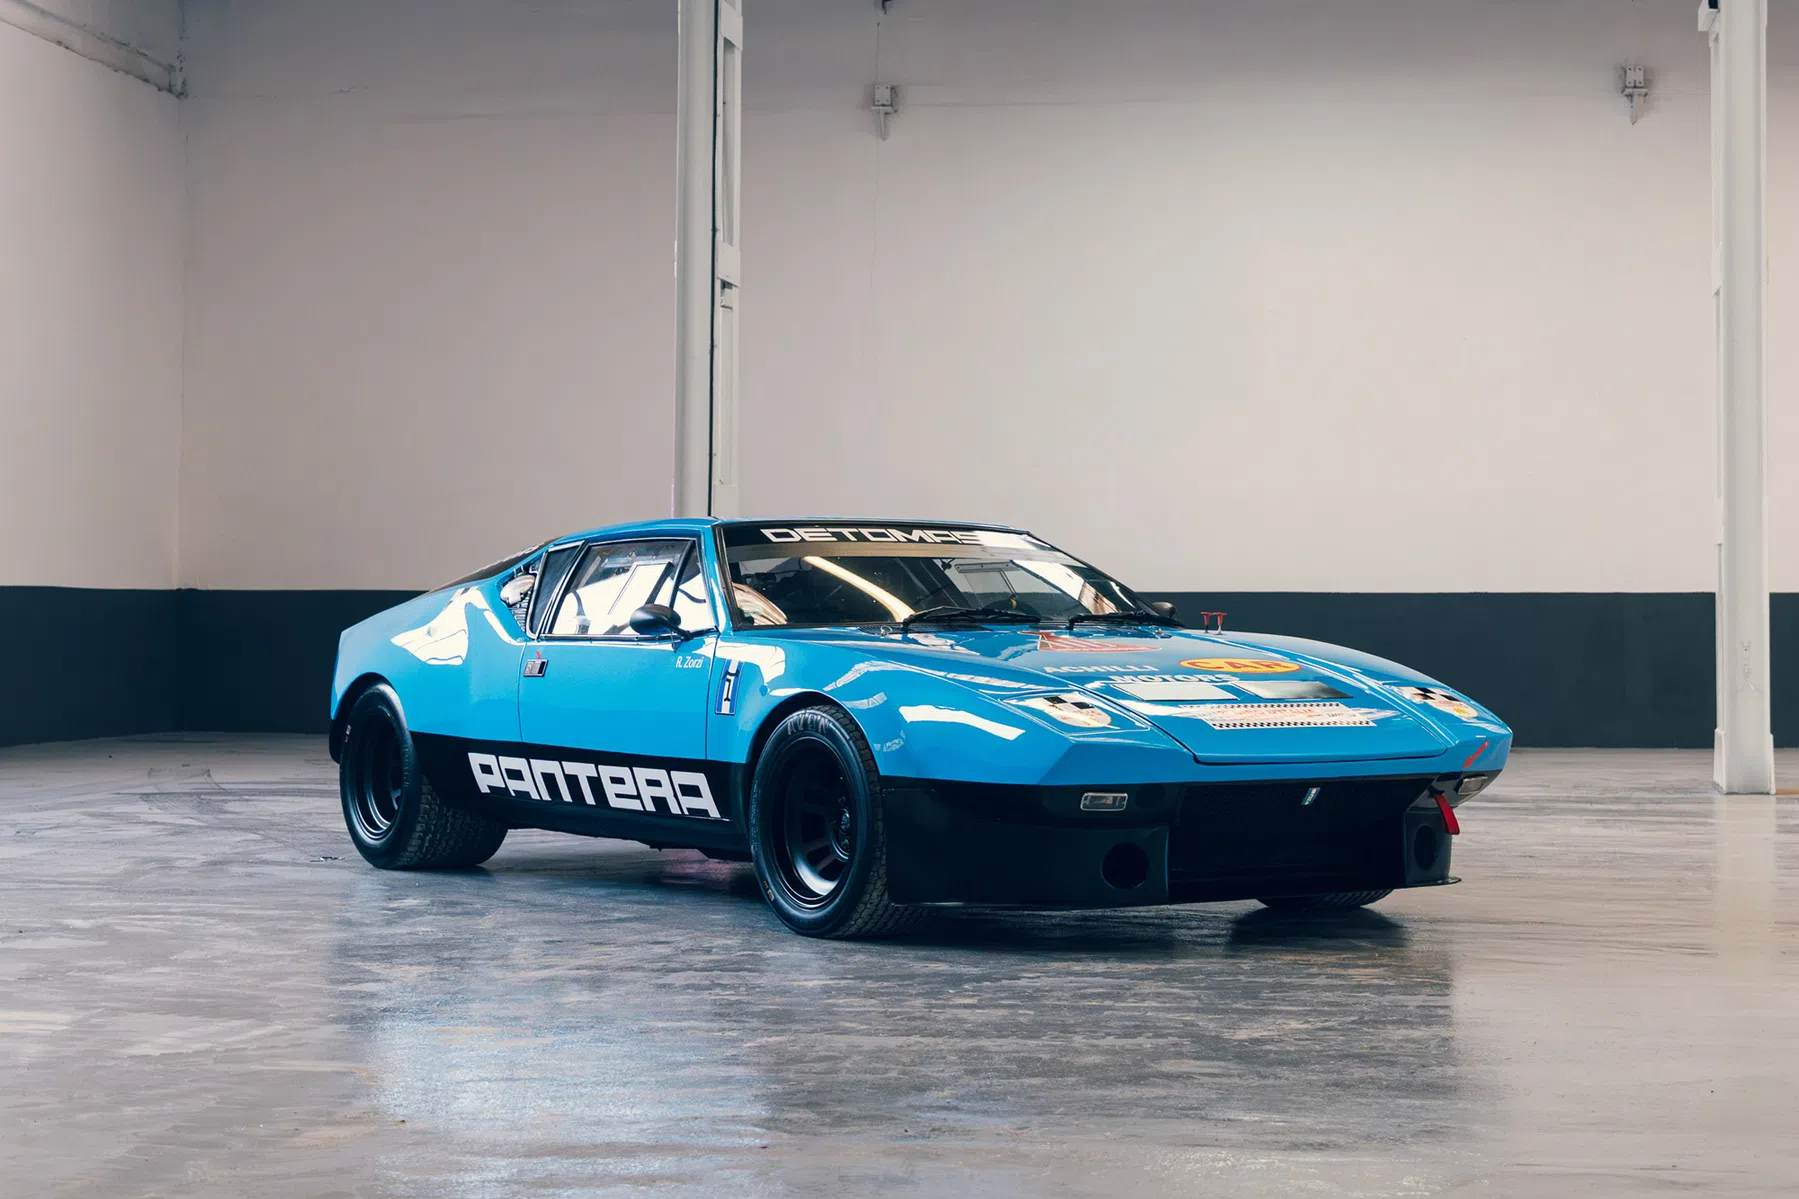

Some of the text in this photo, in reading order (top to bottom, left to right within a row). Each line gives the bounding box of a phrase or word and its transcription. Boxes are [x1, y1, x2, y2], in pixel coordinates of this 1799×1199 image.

[760, 527, 985, 546] DETOMAS
[675, 655, 705, 668] R. Zorzi
[1187, 661, 1293, 669] CAR
[1043, 665, 1160, 673] ACHILLI
[1108, 674, 1240, 683] MOTORS
[467, 752, 722, 819] PANTERA
